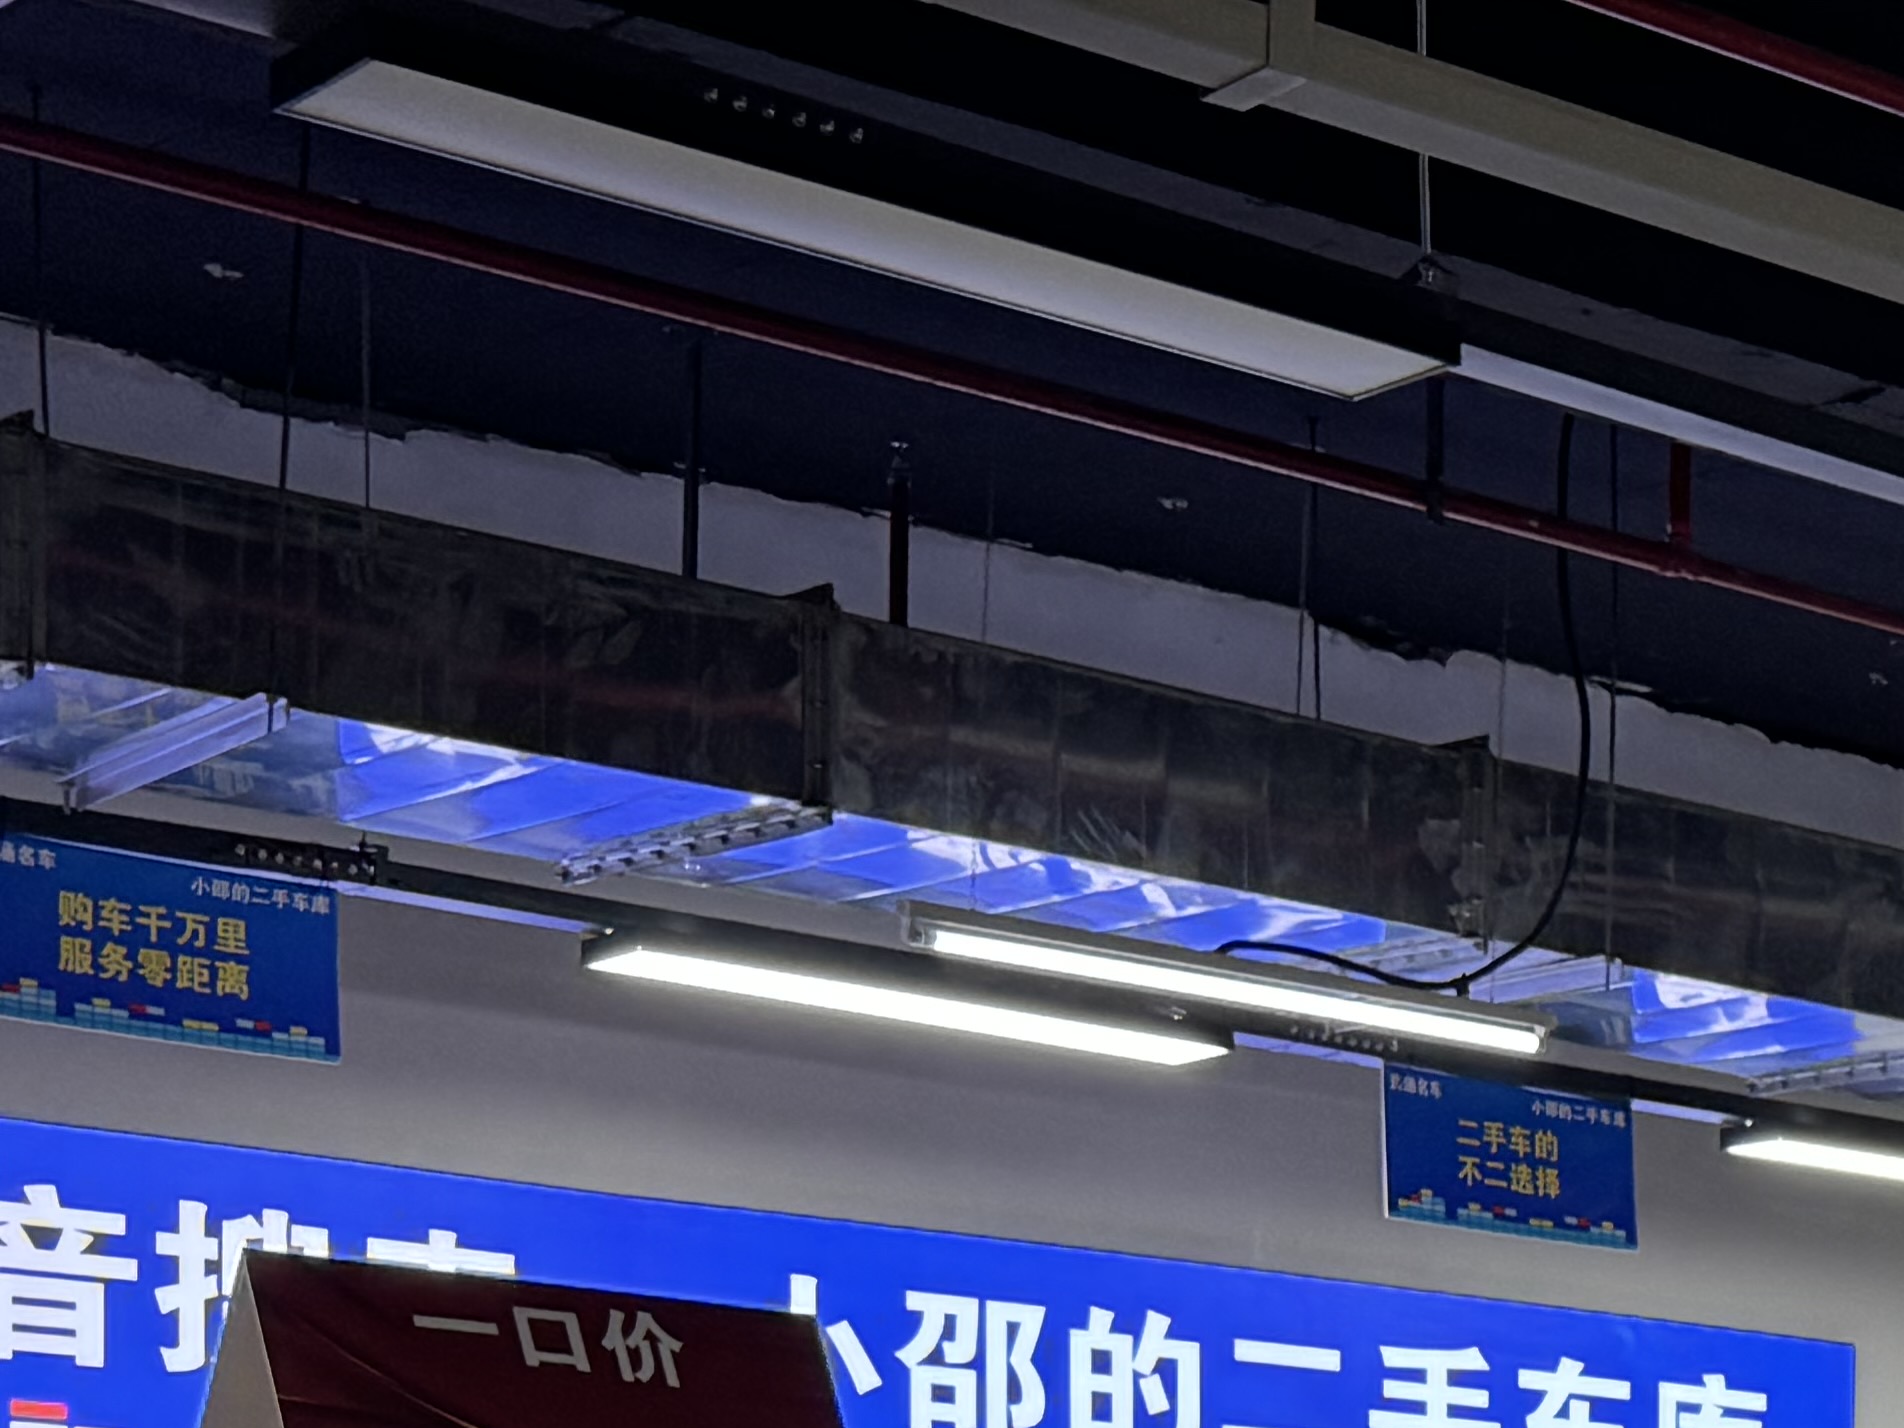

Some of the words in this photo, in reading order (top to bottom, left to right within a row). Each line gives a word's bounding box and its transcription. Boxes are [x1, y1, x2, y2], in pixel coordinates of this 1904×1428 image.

[58, 890, 250, 956] 购车千万里
[191, 876, 330, 915] 小邵的二手车库
[57, 935, 250, 1001] 服务零距离
[1456, 1119, 1559, 1162] 二手车的
[1457, 1155, 1561, 1200] 不二选择
[412, 1302, 684, 1390] 一口价
